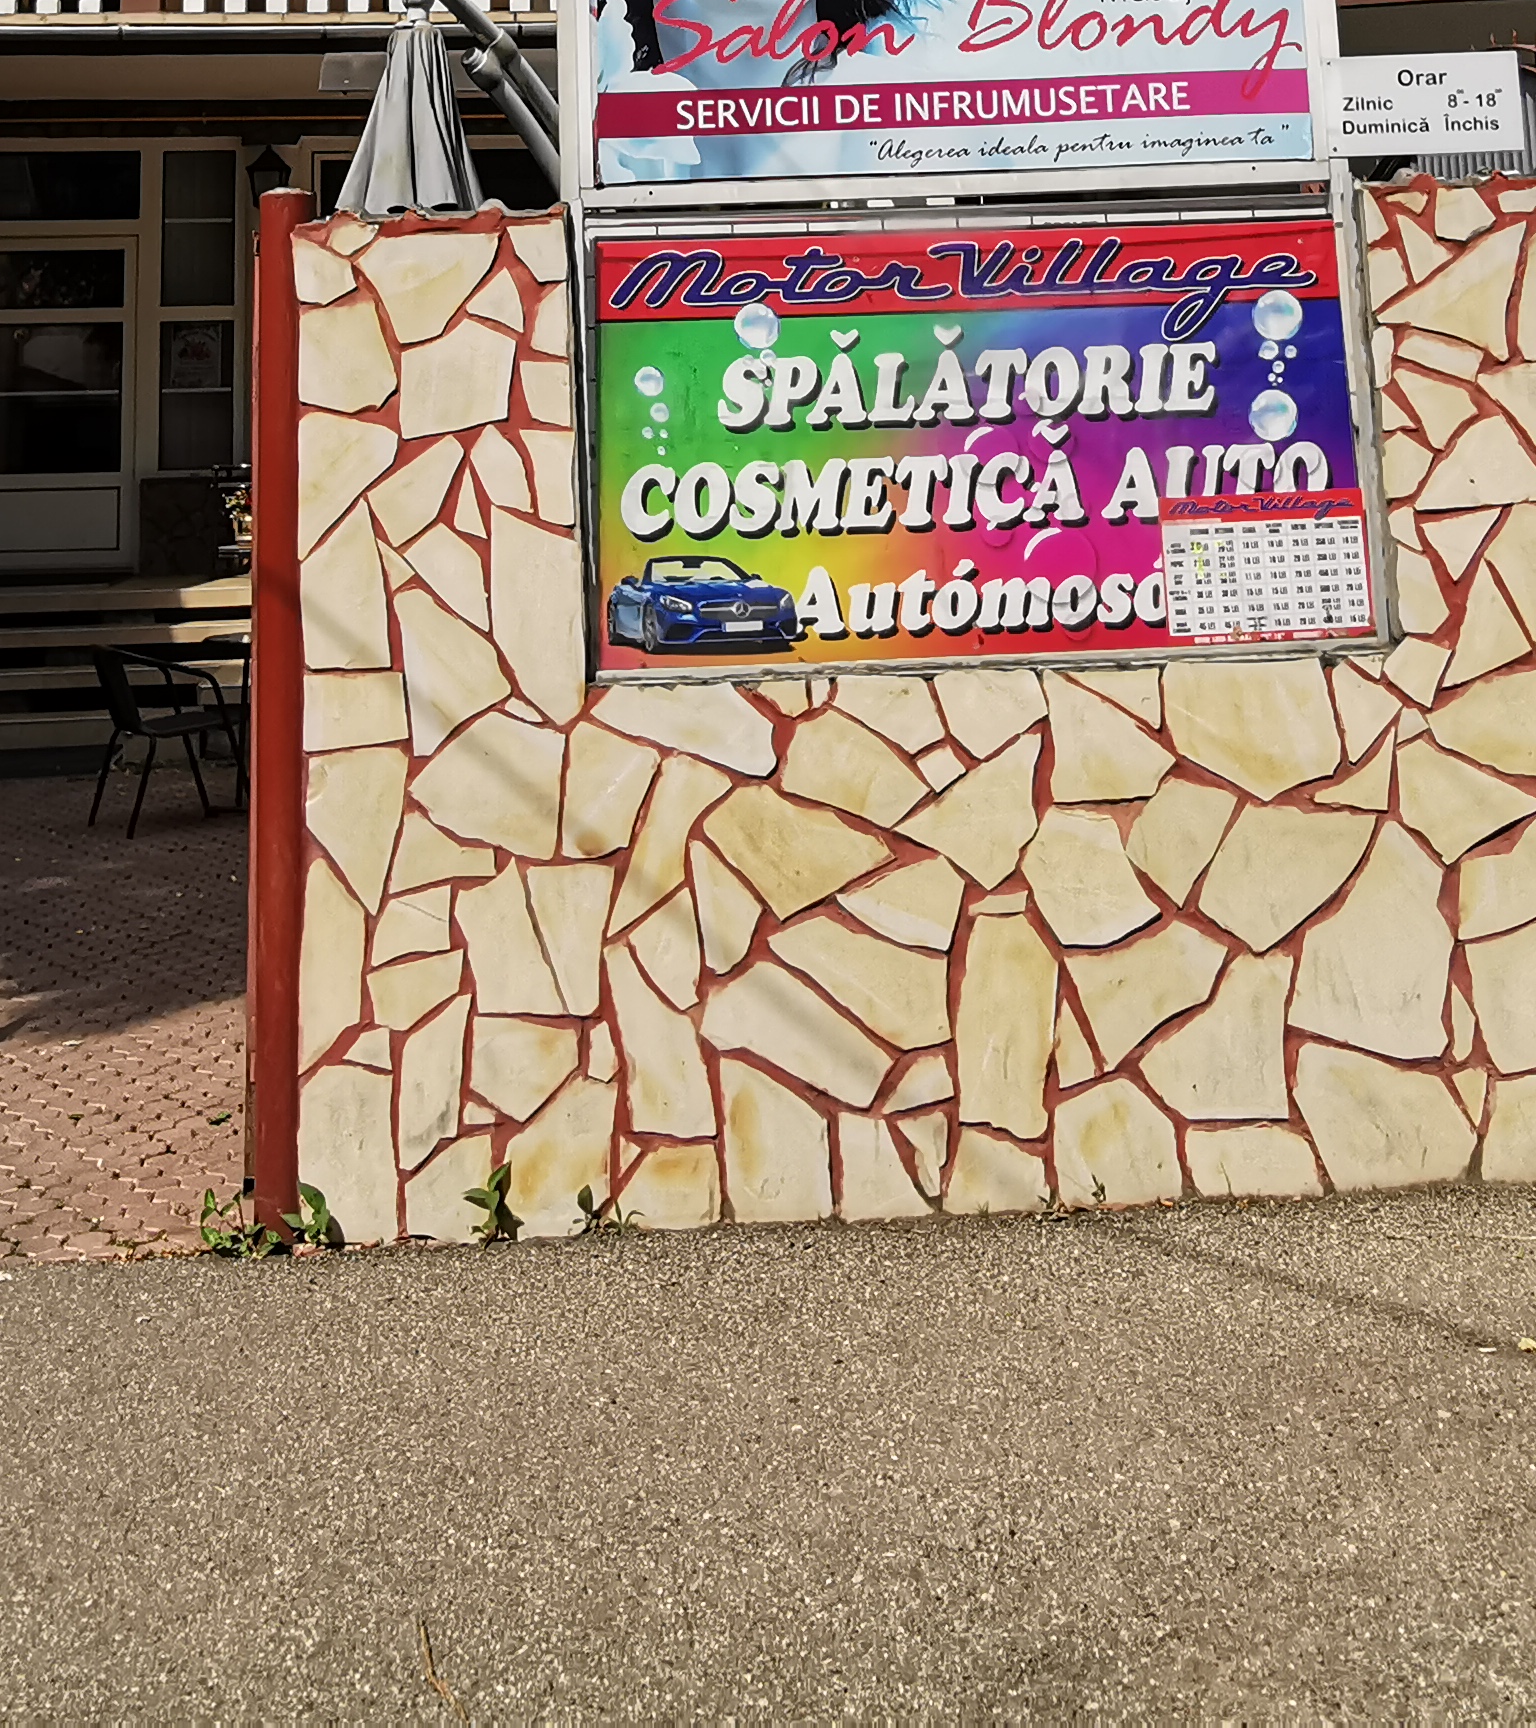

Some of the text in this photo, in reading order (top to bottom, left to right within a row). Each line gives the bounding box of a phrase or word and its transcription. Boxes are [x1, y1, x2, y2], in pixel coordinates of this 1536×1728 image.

[1397, 69, 1447, 86] Orar
[676, 81, 1191, 131] SERVICII DE INFRUMUSETARE
[1342, 96, 1394, 111] Zilnic
[1342, 113, 1500, 135] Duminică Închis
[978, 135, 1049, 158] ideala
[1054, 135, 1134, 161] pentru
[1140, 131, 1244, 158] imaginea
[609, 236, 1317, 341] Motor Village
[717, 324, 1219, 431] SPĂLĂTORIE
[621, 419, 1088, 542] COSMETICĂ
[1169, 495, 1355, 521] Motor Village
